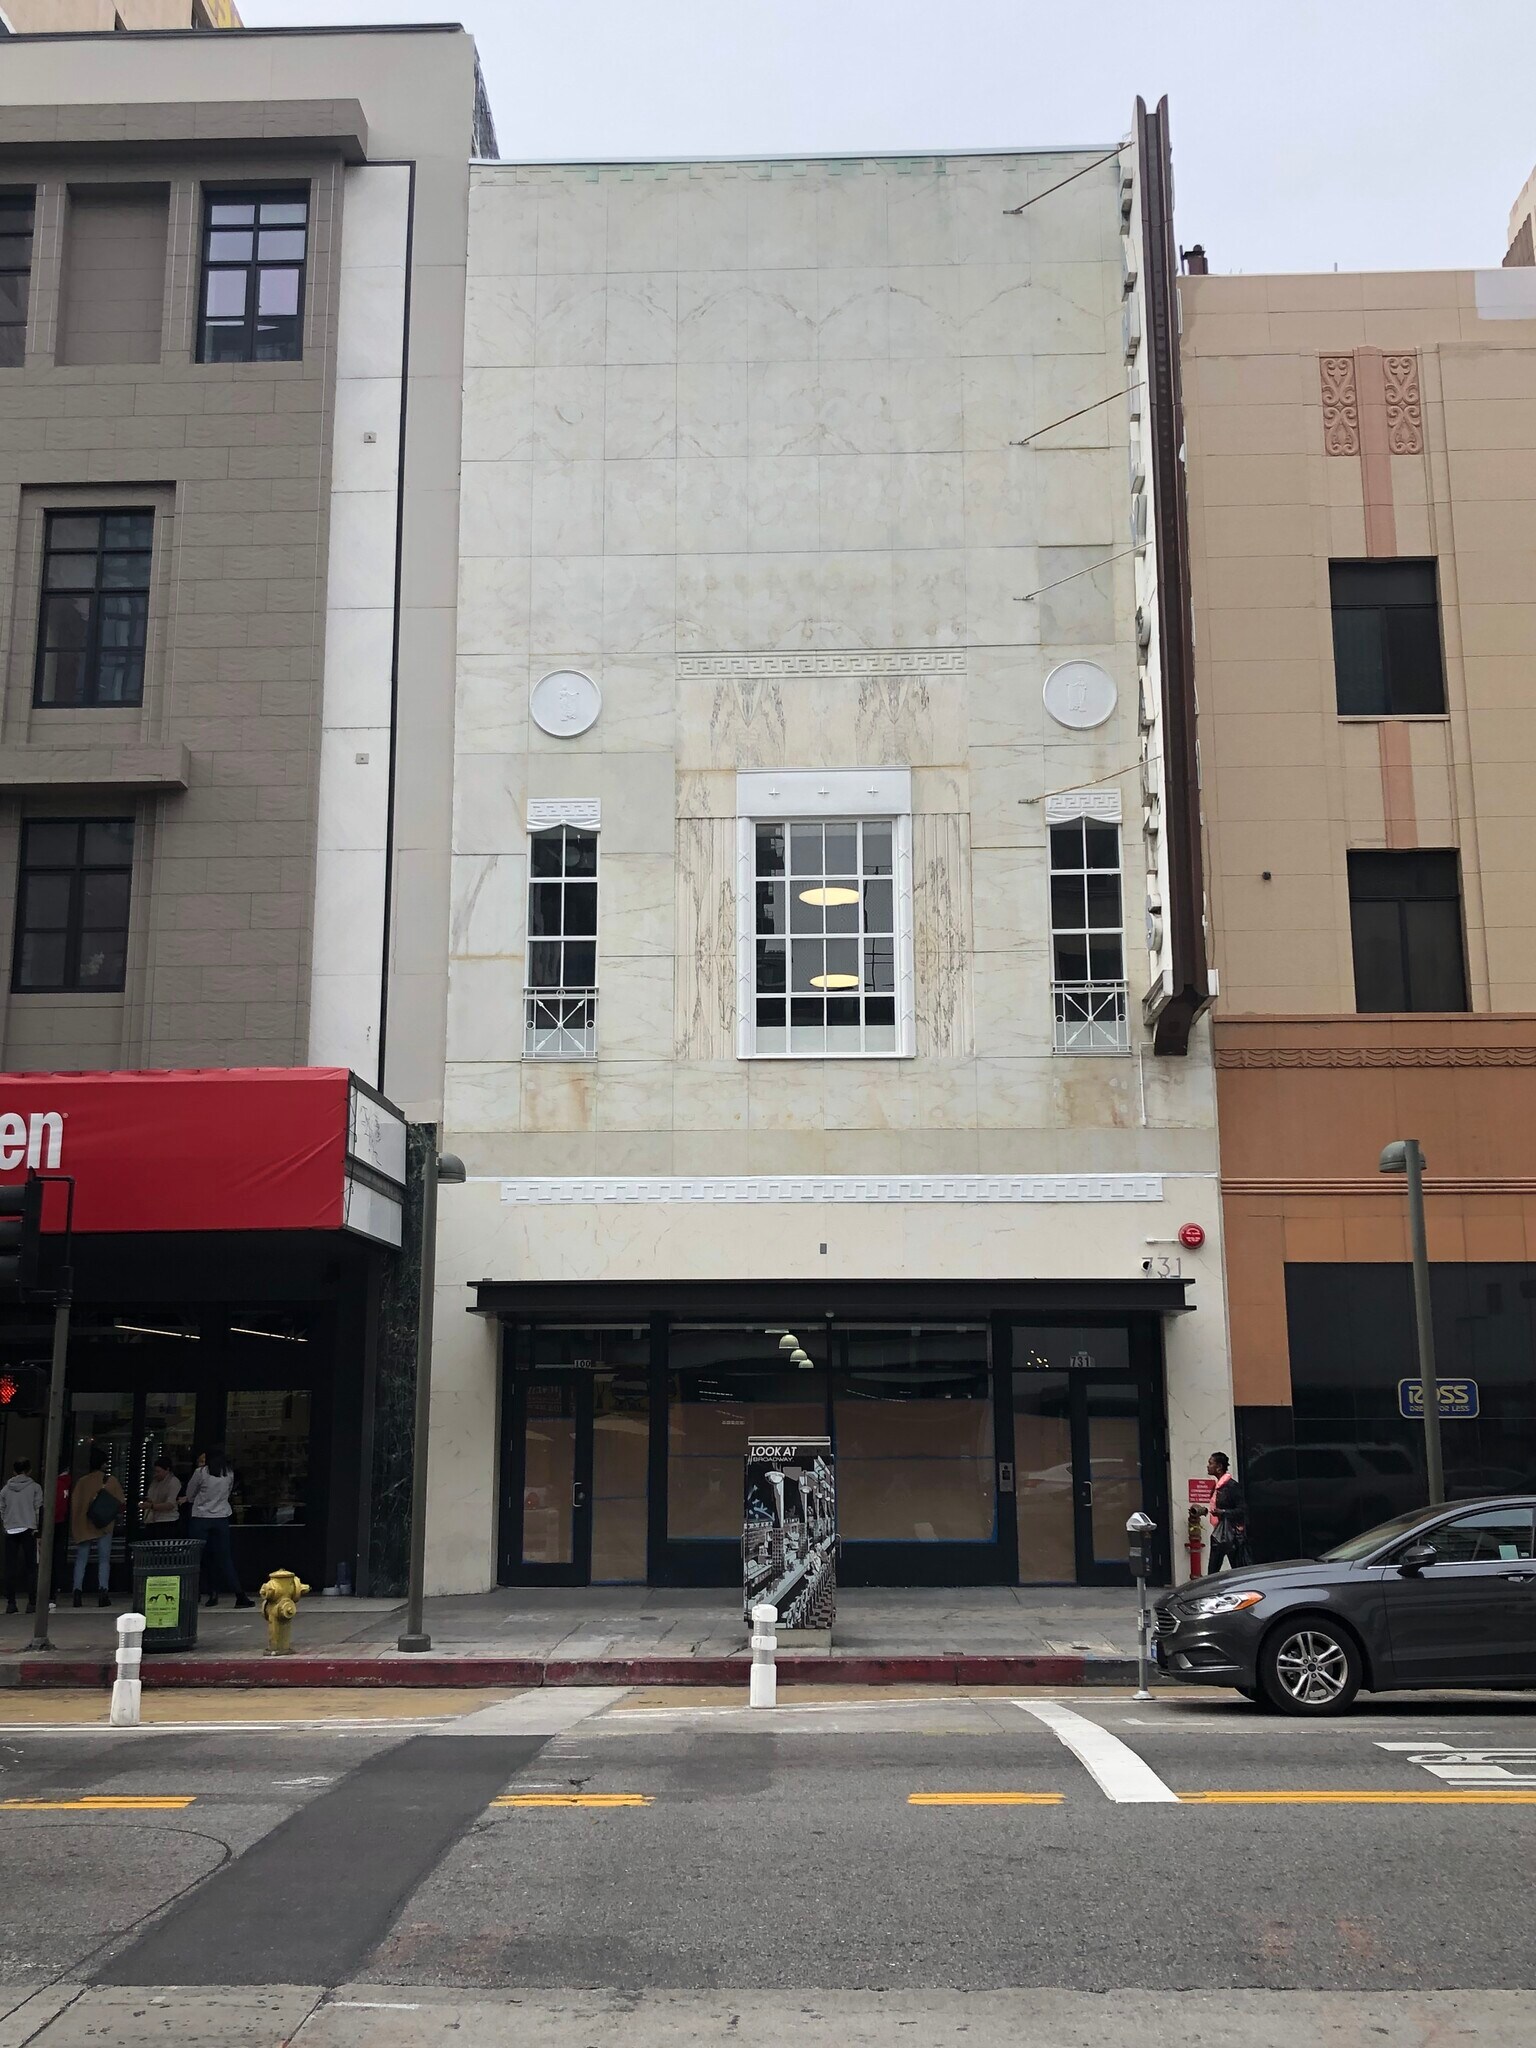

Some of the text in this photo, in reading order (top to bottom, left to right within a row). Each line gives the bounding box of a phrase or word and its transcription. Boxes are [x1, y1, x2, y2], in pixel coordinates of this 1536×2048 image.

[1142, 1256, 1182, 1278] 731
[1071, 1356, 1089, 1368] 731
[1408, 1385, 1469, 1404] RSS
[751, 1446, 798, 1457] LOOK AT
